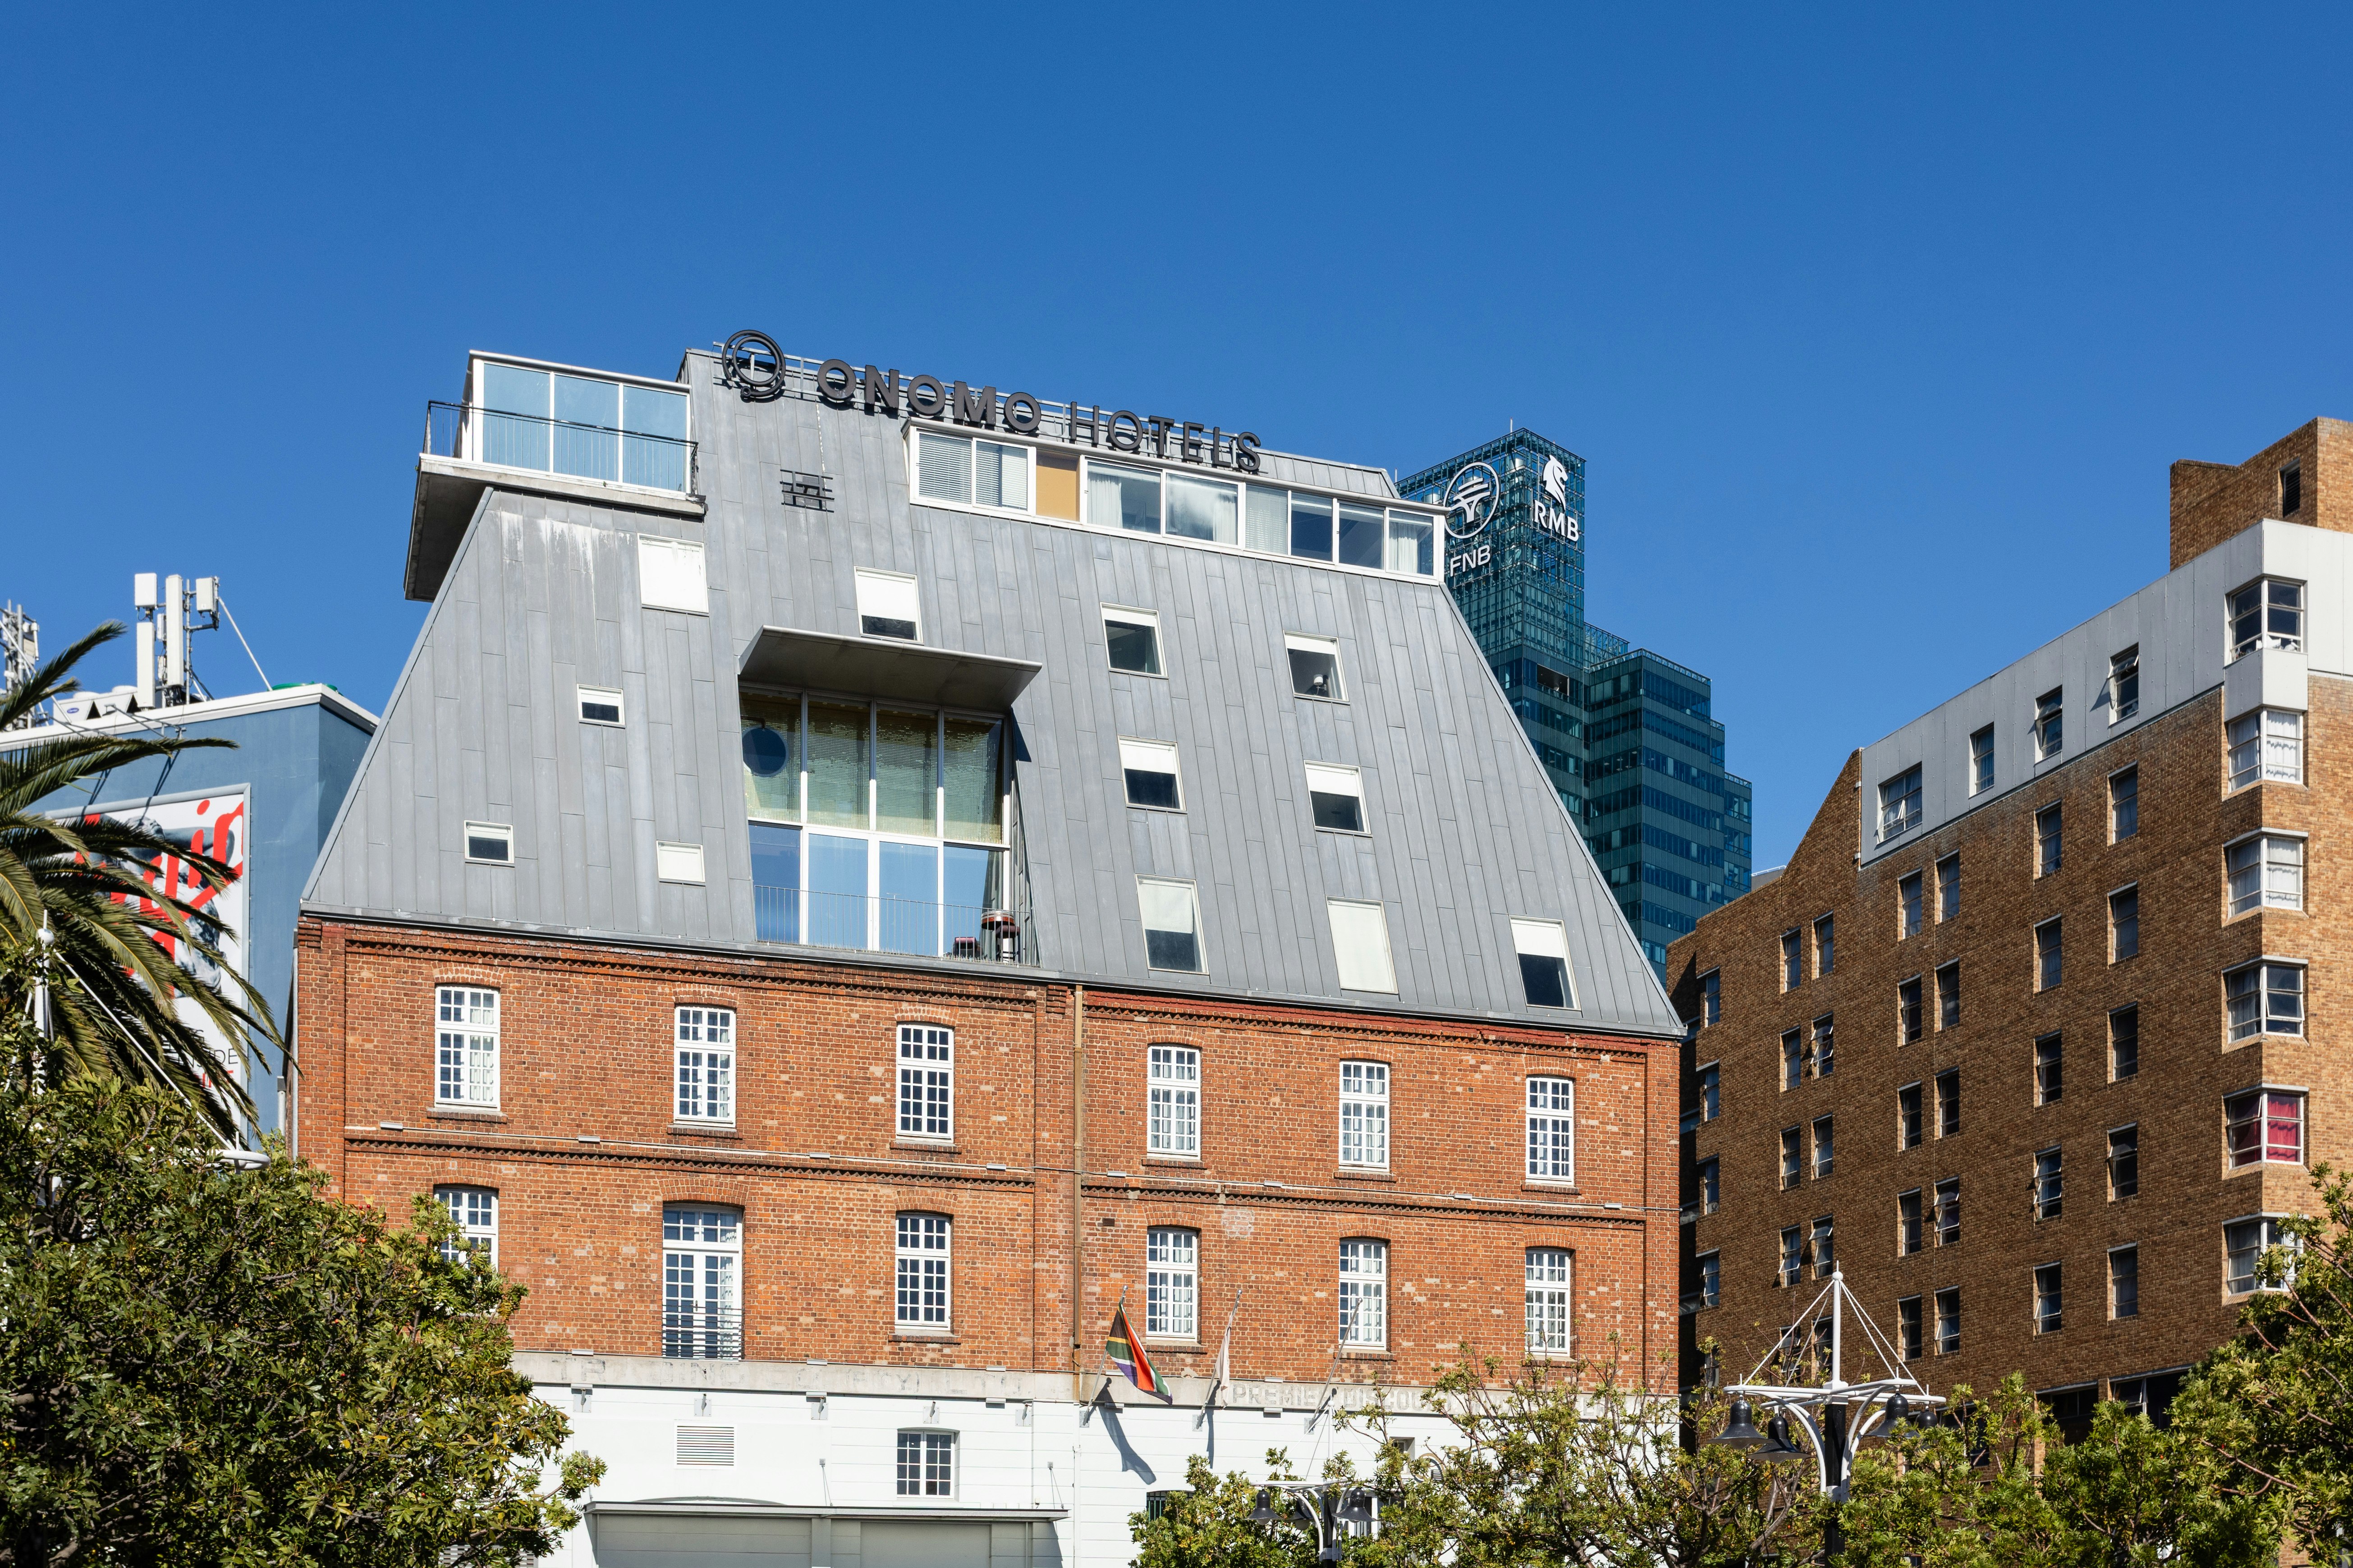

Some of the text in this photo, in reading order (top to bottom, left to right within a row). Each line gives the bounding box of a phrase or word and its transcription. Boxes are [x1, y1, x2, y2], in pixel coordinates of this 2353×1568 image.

[817, 358, 1262, 472] ONOMO HOTELS
[1534, 499, 1579, 541] RMB
[1450, 545, 1491, 577] FNB
[1233, 1382, 1333, 1407] PREMIE
